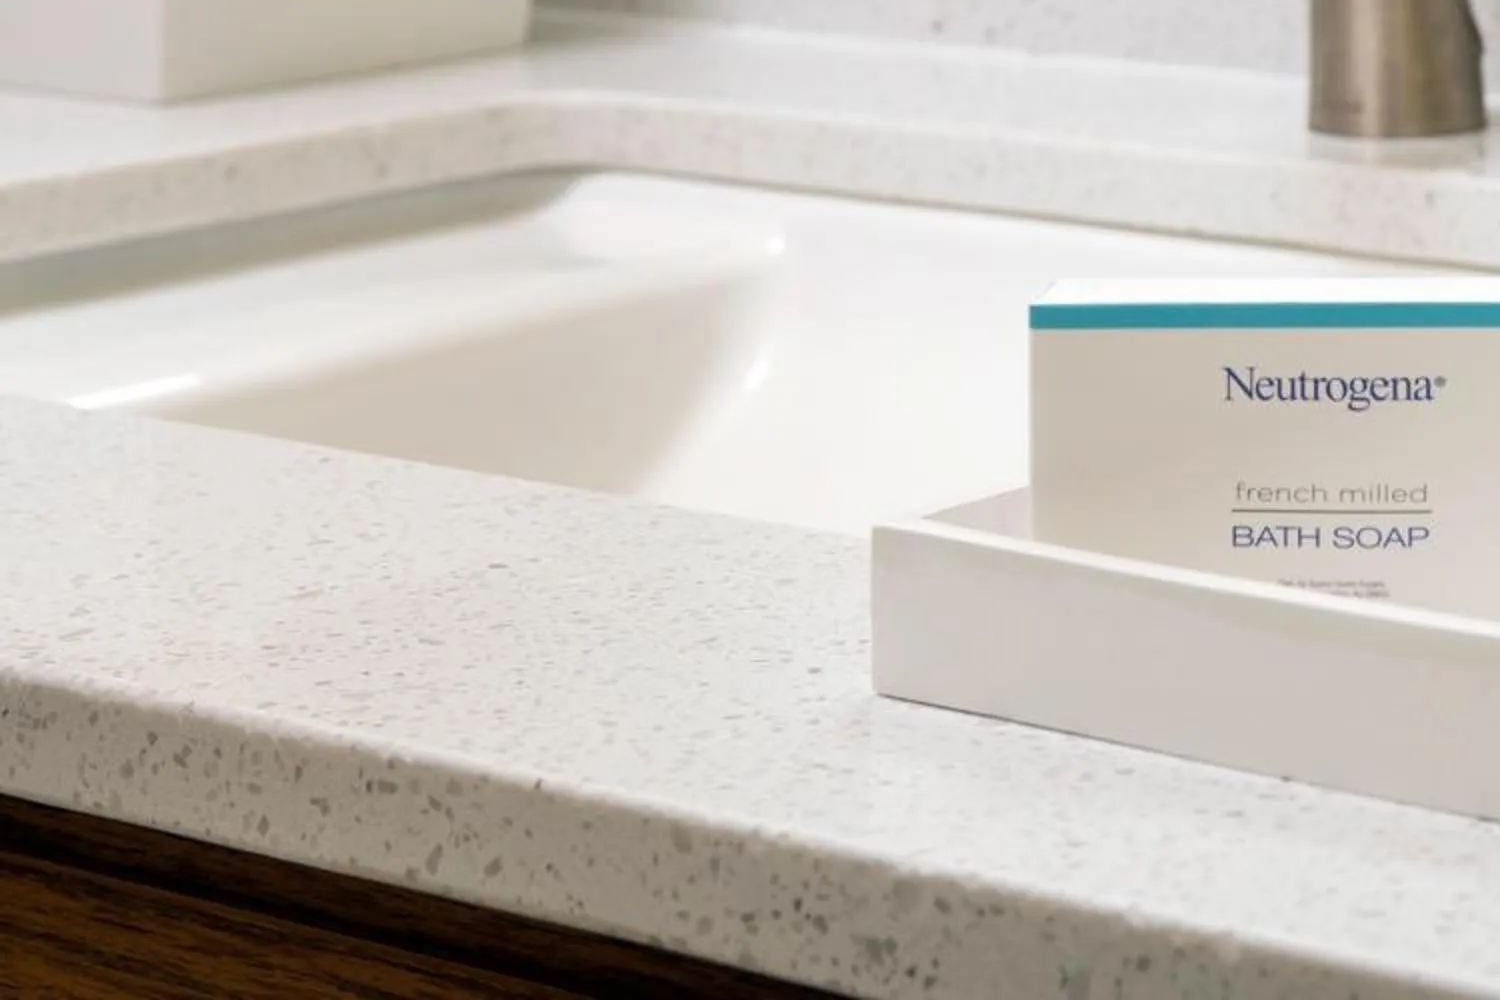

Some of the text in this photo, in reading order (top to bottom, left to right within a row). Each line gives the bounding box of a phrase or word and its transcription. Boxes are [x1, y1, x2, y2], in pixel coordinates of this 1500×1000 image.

[1235, 481, 1428, 504] french milled
[1231, 524, 1431, 549] BATH SOAP
